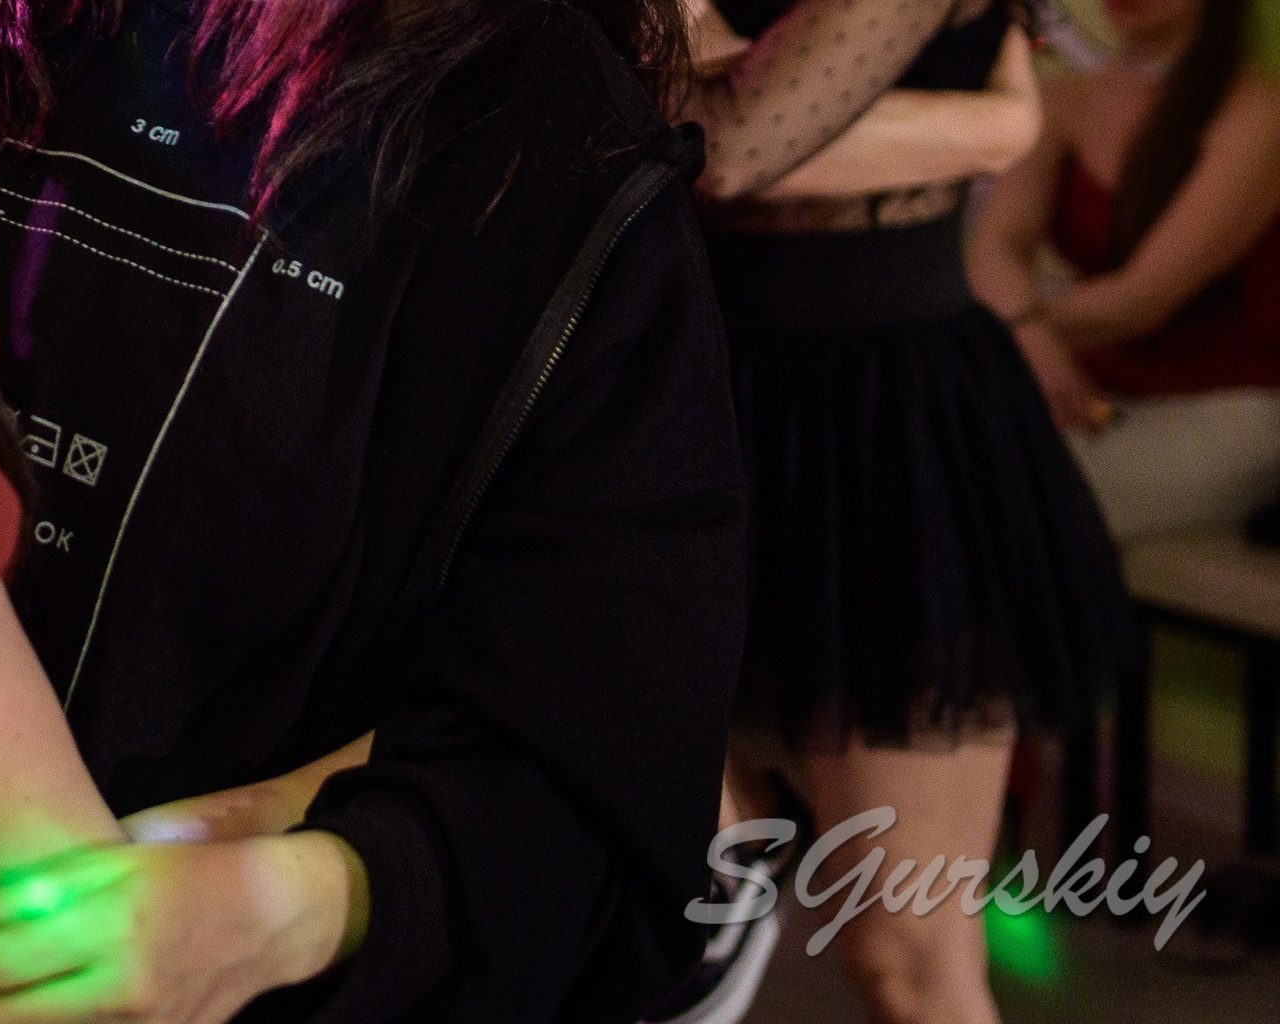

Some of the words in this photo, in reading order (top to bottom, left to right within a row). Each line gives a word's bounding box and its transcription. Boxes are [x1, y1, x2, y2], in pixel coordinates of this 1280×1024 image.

[130, 118, 147, 134] 3
[148, 125, 181, 146] cm
[271, 258, 303, 277] 0.5
[306, 270, 346, 300] cm
[34, 520, 75, 553] OK
